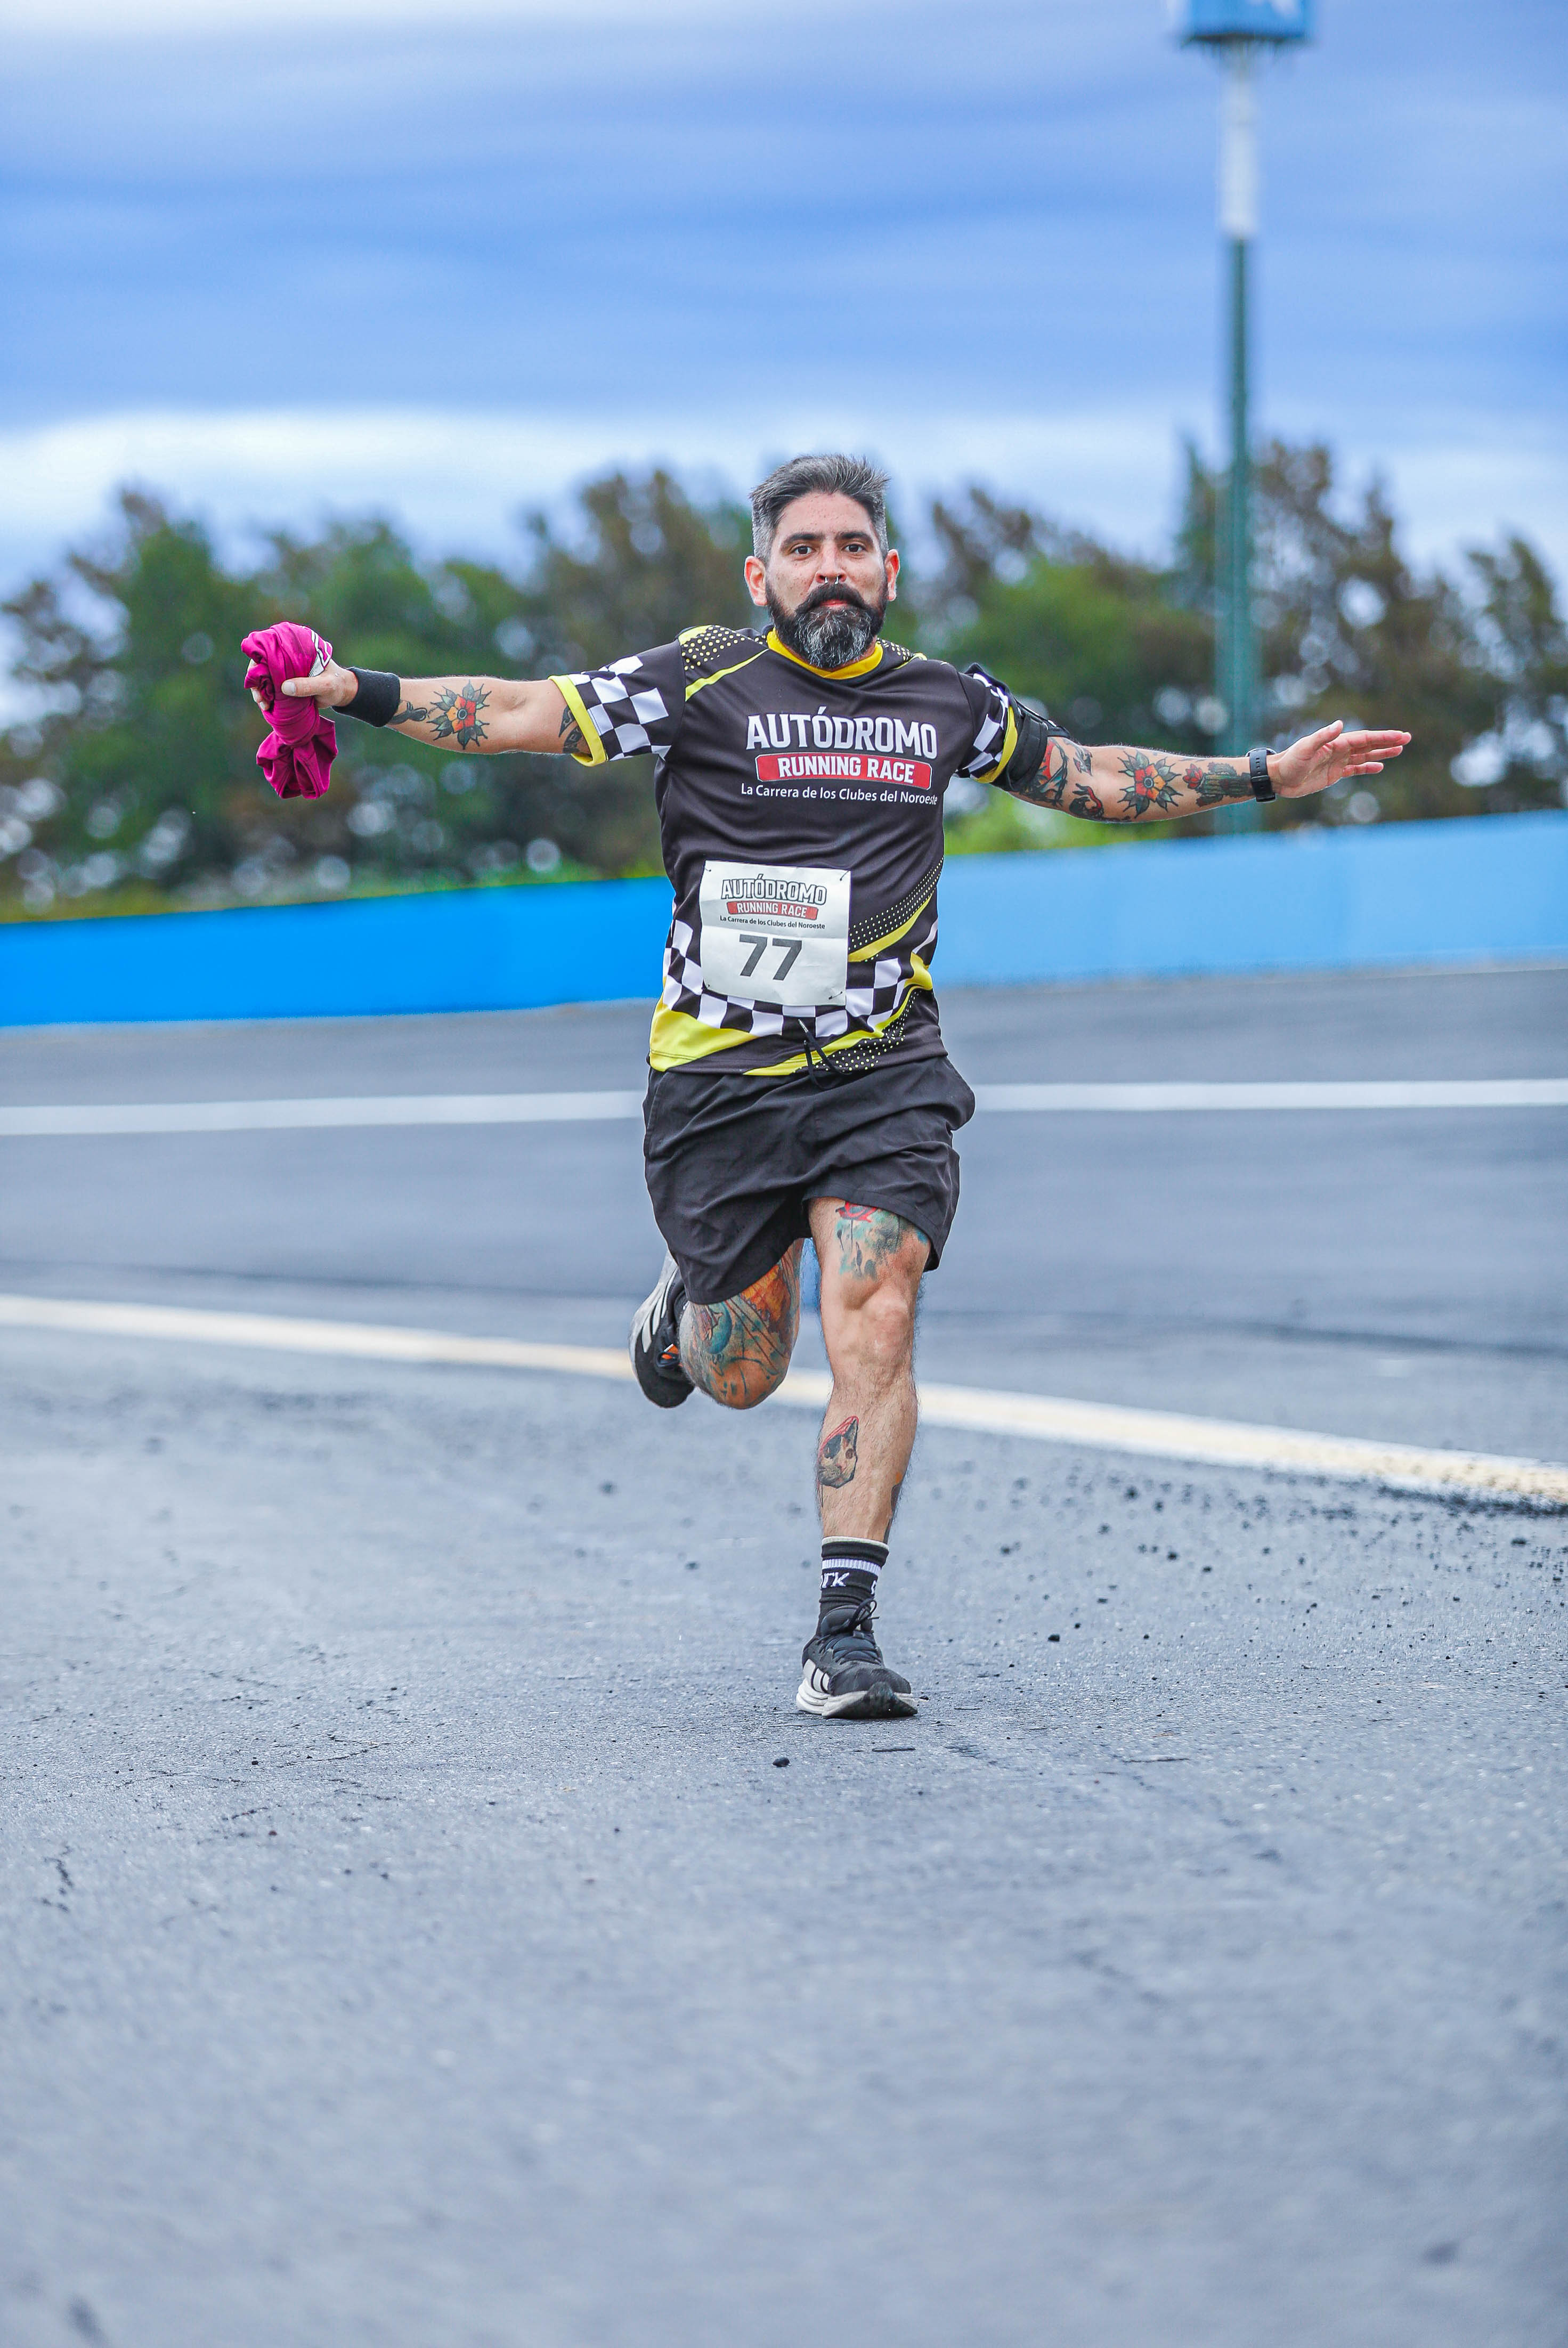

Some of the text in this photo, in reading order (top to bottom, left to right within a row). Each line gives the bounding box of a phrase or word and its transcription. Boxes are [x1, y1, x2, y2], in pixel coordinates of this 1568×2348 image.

[746, 706, 938, 759] AUTÓDROMO
[777, 755, 915, 784] RUNNING RACE
[741, 783, 938, 805] La Carrera de los Clubes del Noroeste
[721, 874, 827, 905] AUTÓDROMO
[737, 902, 808, 918] RUNNING RACE
[739, 934, 802, 981] 77
